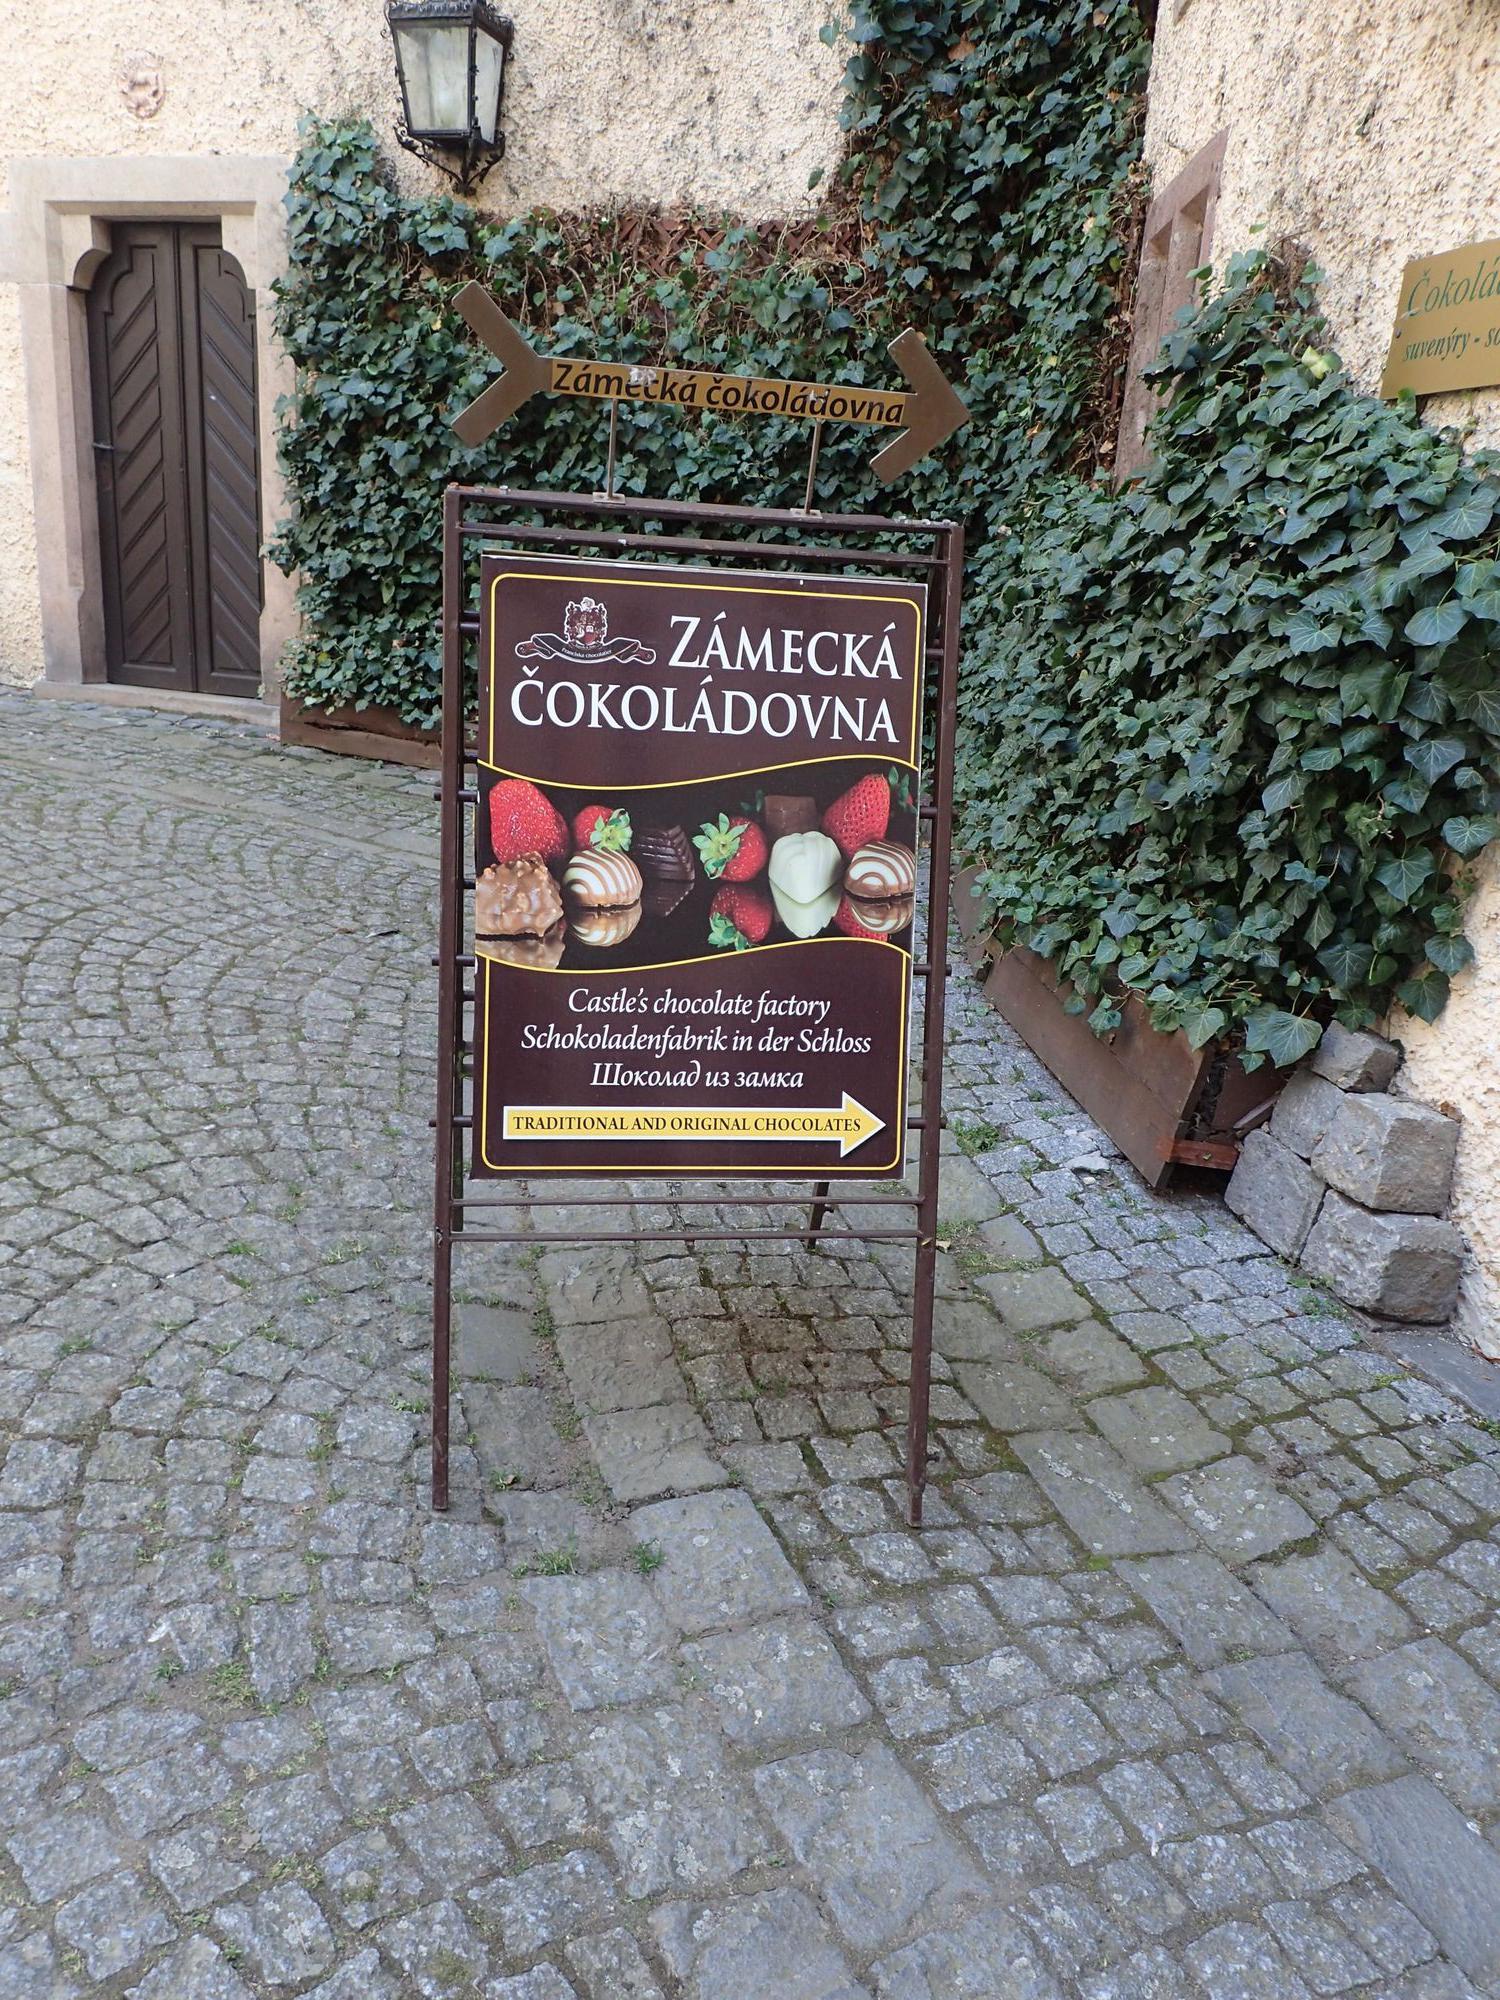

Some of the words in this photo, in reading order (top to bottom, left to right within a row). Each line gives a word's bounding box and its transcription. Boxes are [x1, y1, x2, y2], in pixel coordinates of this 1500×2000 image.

[1403, 327, 1472, 362] suvenýry
[552, 363, 698, 403] Zámecká
[706, 376, 904, 423] čokoládovna
[667, 610, 903, 680] ZÁMECKÁ
[510, 665, 900, 744] ČOKOLÁDOVNA
[568, 987, 649, 1013] Castle's
[653, 988, 753, 1015] chocolate
[751, 990, 831, 1024] factory
[521, 1023, 728, 1058] Schokoladenfabrik
[732, 1030, 752, 1051] in
[758, 1026, 794, 1052] der
[797, 1027, 872, 1053] Schloss
[589, 1060, 701, 1087] Шоколад
[705, 1071, 730, 1087] из
[734, 1071, 804, 1088] замка
[513, 1116, 628, 1130] TRADITIONAL
[631, 1117, 667, 1130] AND
[670, 1117, 751, 1131] ORIGINAL
[754, 1117, 861, 1132] CHOCOLATES
